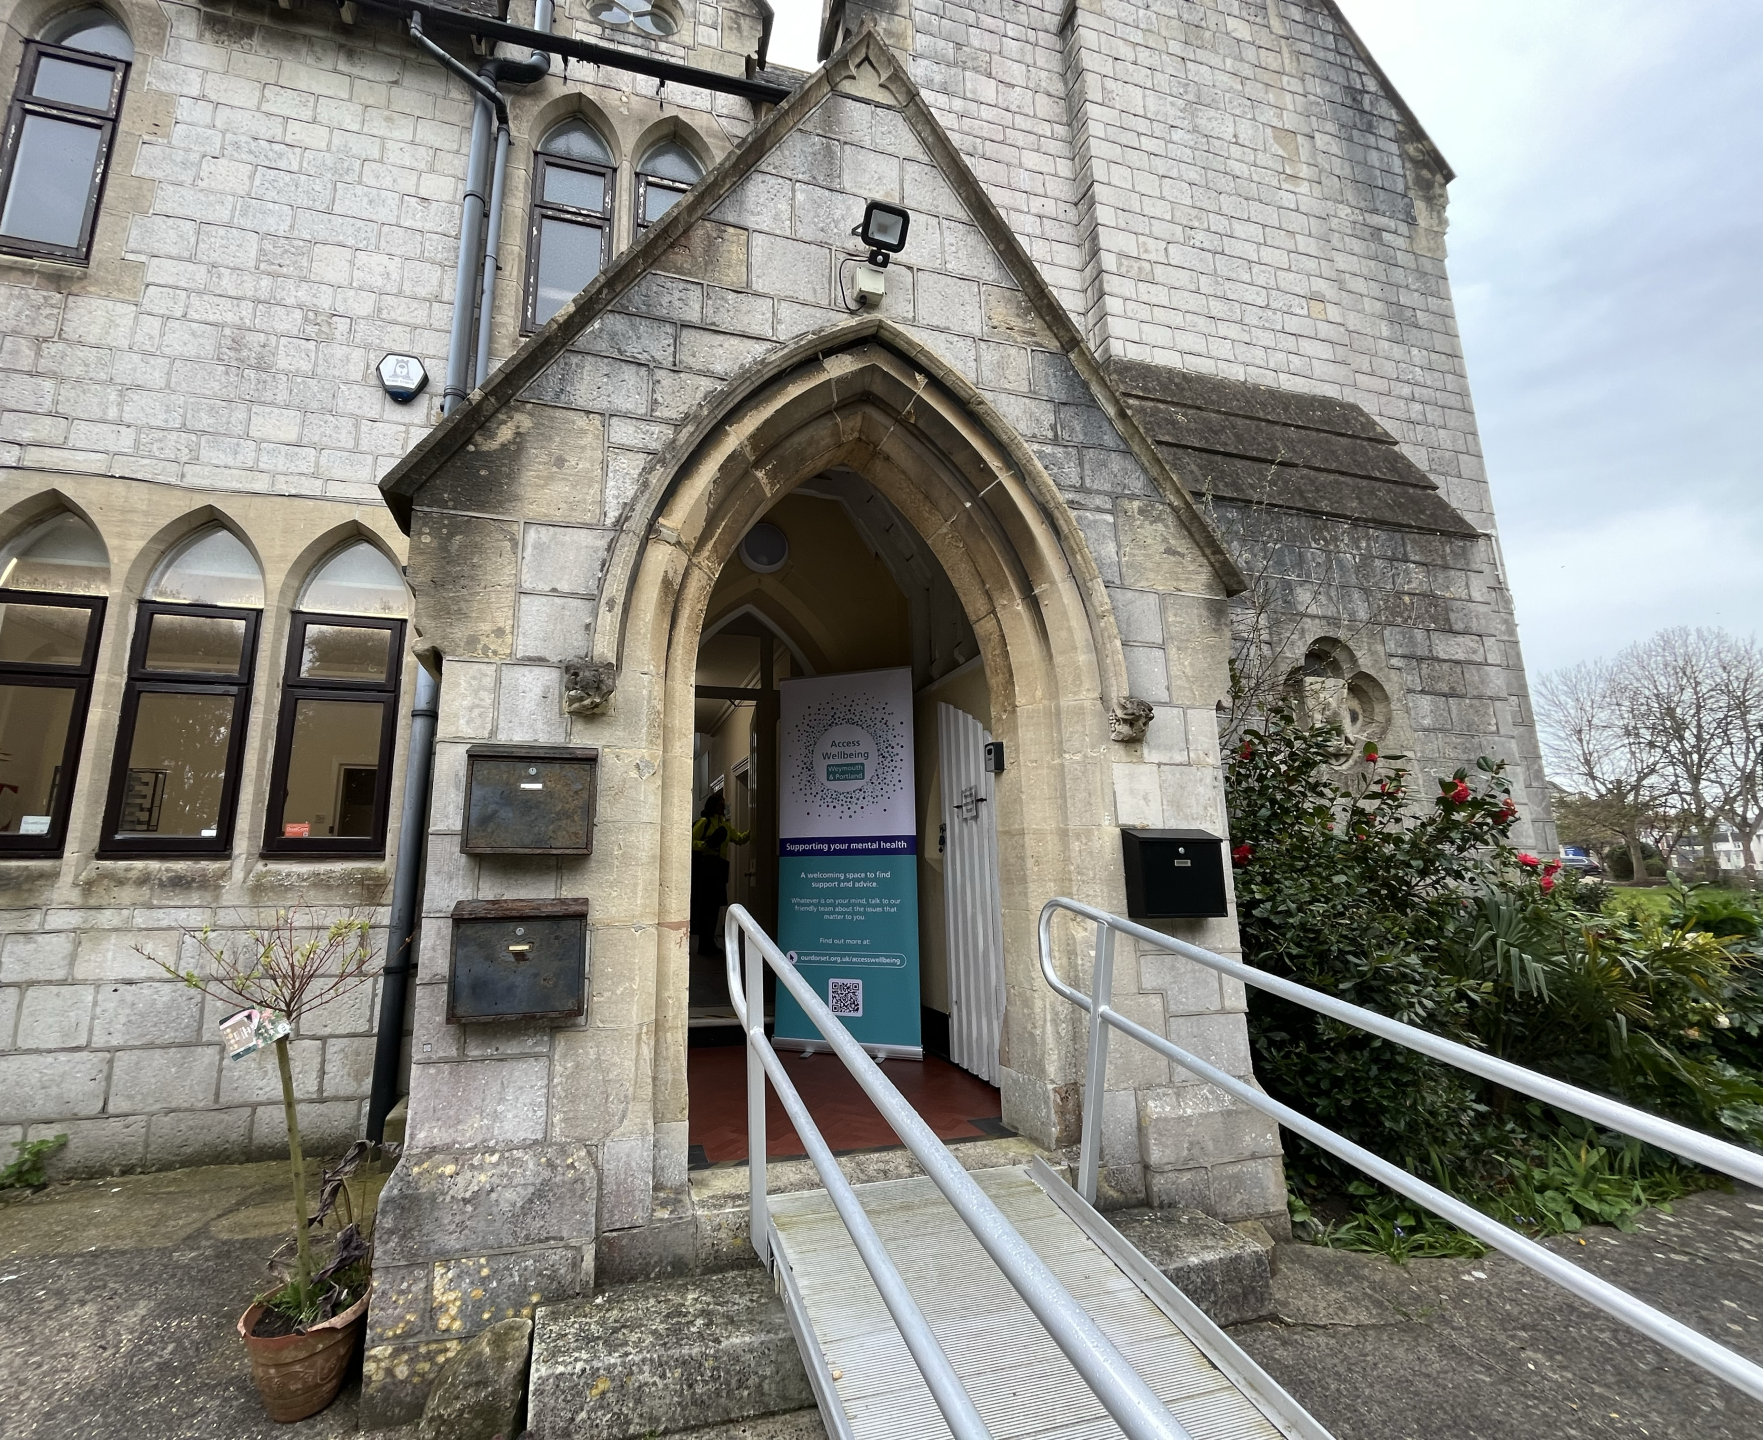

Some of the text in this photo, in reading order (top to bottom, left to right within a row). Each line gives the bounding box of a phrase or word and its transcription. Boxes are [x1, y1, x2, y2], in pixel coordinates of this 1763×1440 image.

[830, 740, 861, 748] Access
[822, 750, 869, 760] Wellbeing
[786, 840, 907, 852] Supporting your mental health
[800, 955, 900, 965] ourdorset.org.uk/accesswellbeing
